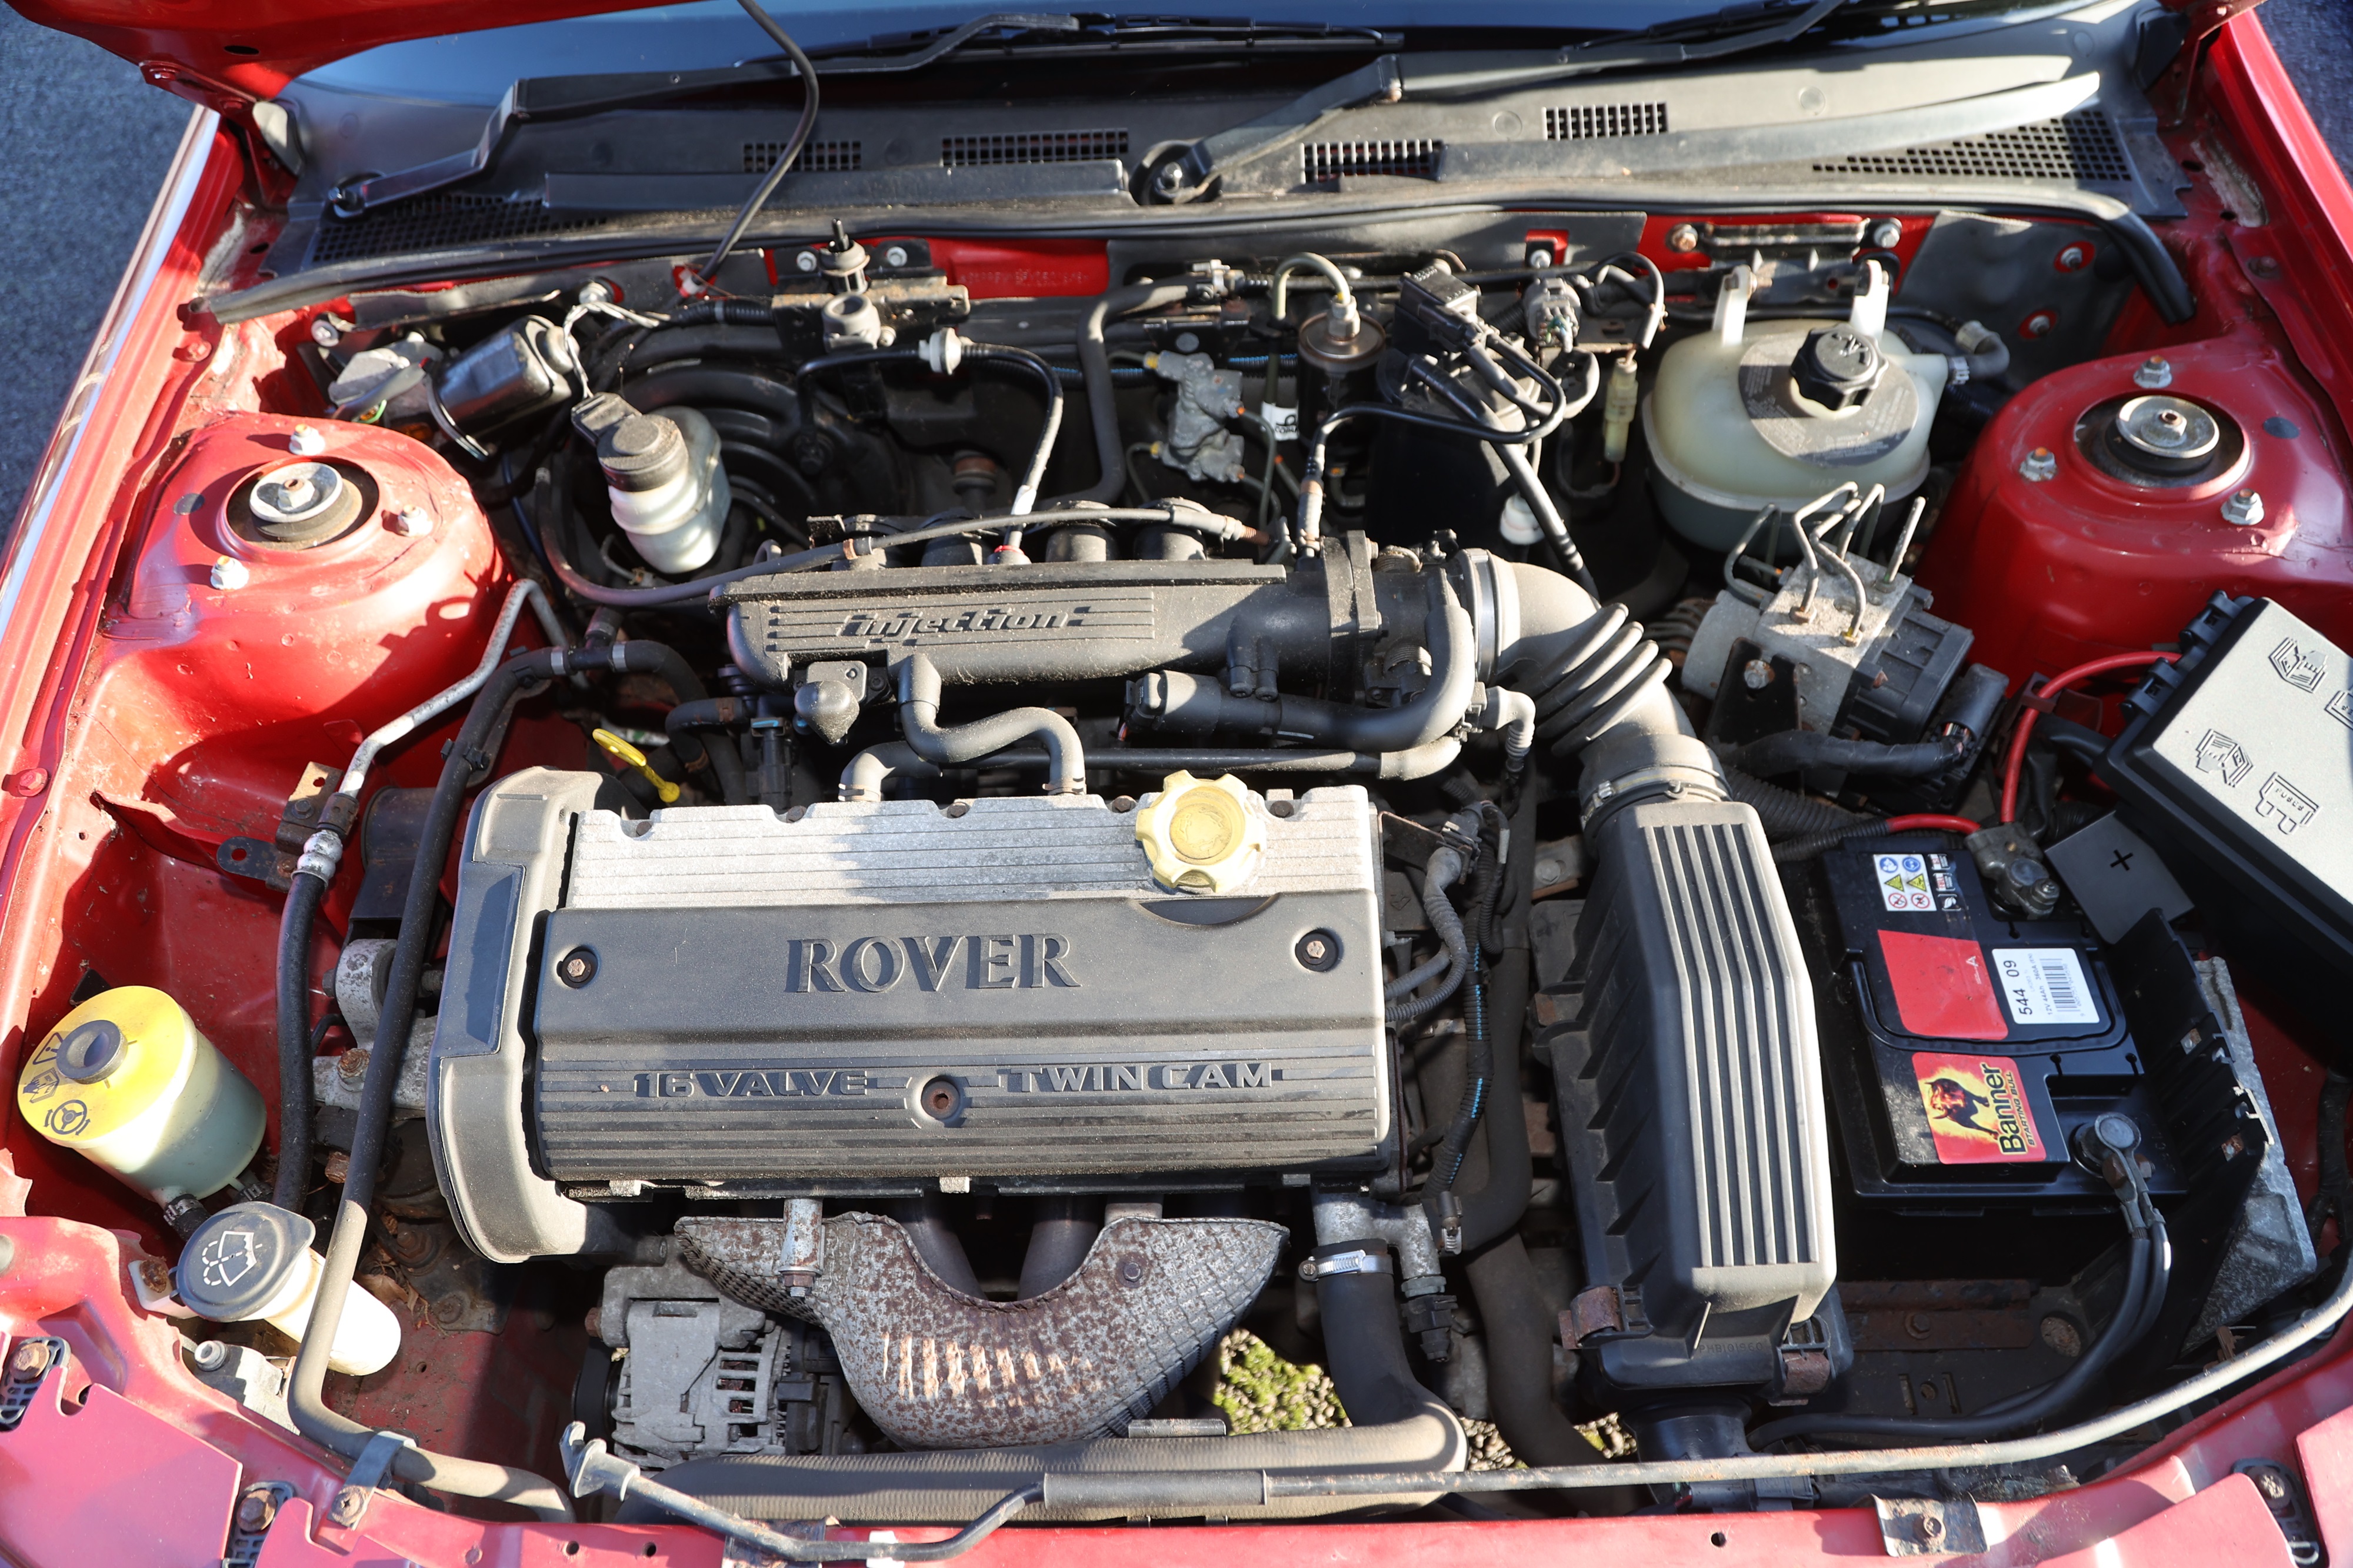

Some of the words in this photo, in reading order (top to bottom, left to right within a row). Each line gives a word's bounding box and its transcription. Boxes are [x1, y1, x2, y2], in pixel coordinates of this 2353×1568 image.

[851, 607, 1069, 642] injection
[2275, 788, 2305, 812] FUSES
[788, 933, 1082, 993] ROVER
[2003, 960, 2019, 977] 09
[2031, 965, 2041, 980] 360A
[2012, 989, 2032, 1015] 544
[2039, 985, 2048, 1002] 44Ah
[2044, 1004, 2052, 1015] 12V
[643, 1072, 695, 1097] 16
[702, 1070, 868, 1097] VALVE
[1009, 1065, 1144, 1093] TWIN
[1161, 1062, 1272, 1090] CAM
[2006, 1072, 2018, 1096] BULL
[1981, 1063, 2027, 1153] Banner
[2014, 1098, 2035, 1146] STARTING
